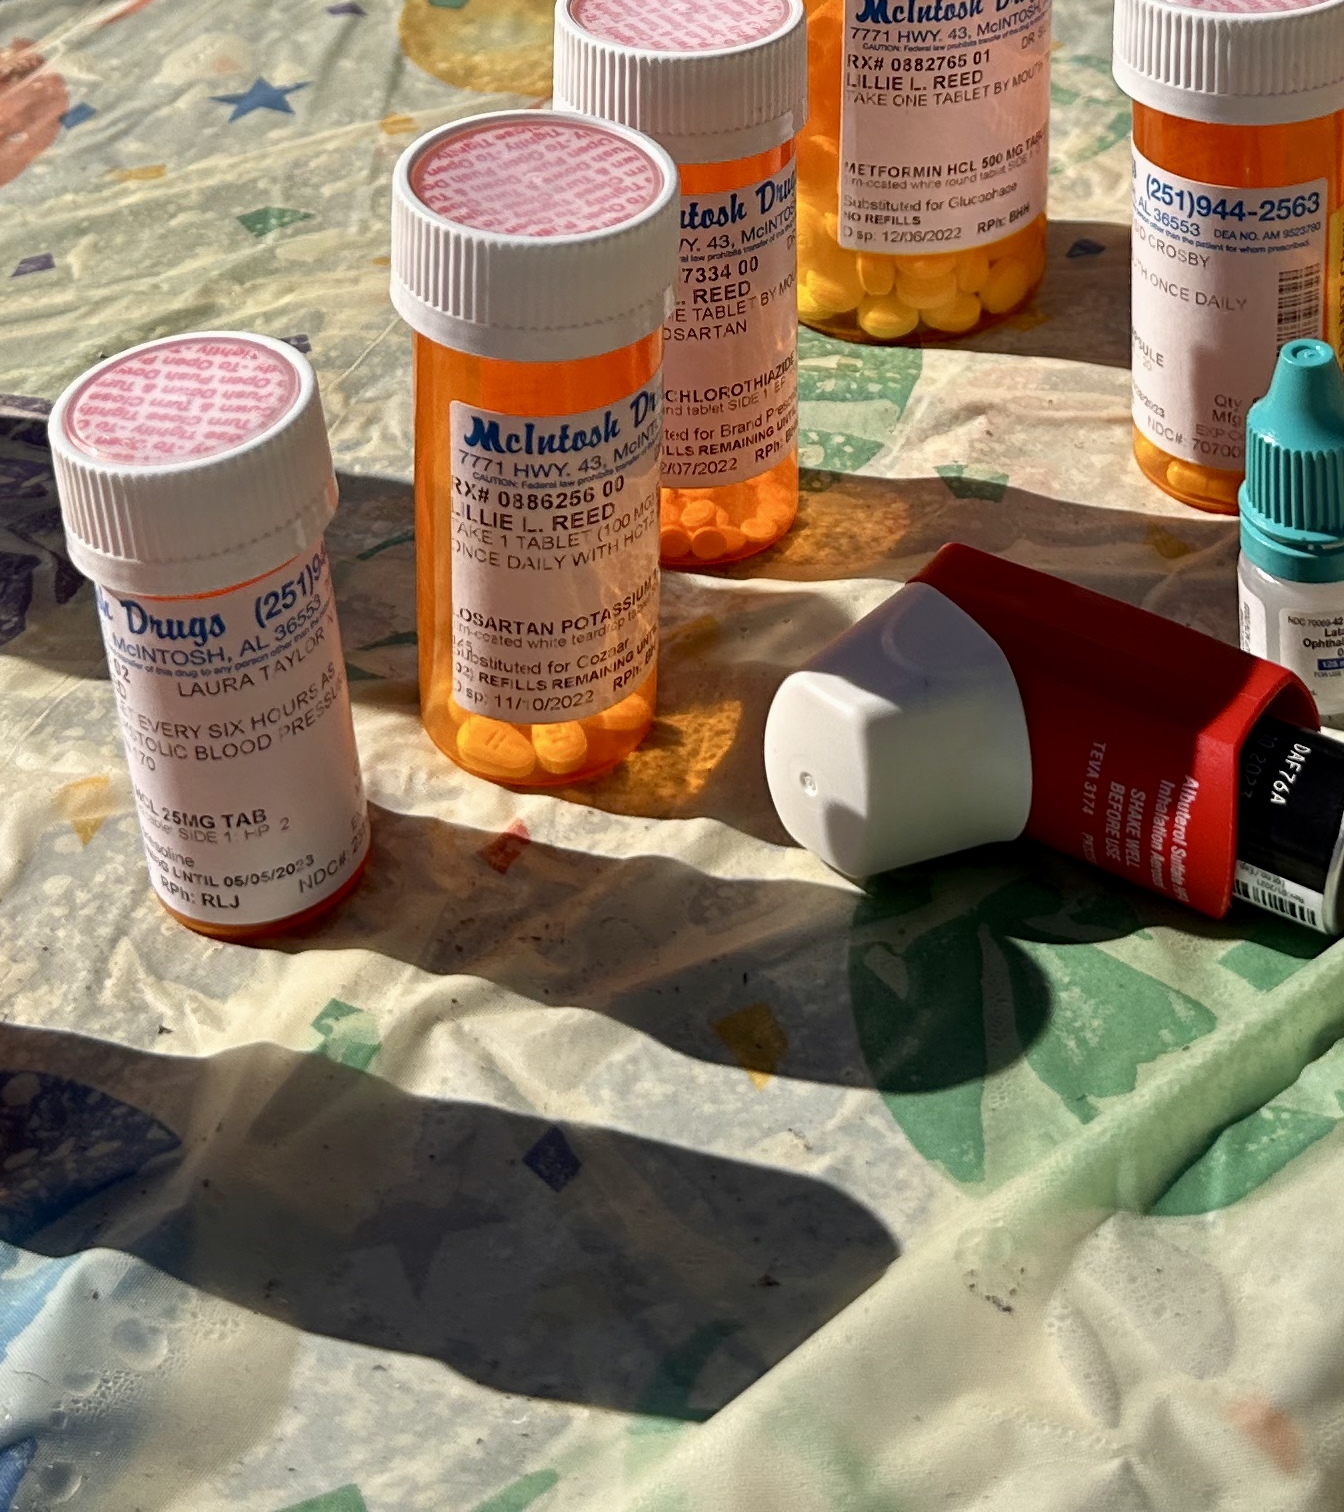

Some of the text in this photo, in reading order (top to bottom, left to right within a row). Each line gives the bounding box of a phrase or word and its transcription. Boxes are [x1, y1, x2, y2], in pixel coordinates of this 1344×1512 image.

[850, 27, 972, 43] 7771 HWY. 43,
[847, 49, 991, 72] RX# 0882765 01
[845, 79, 1010, 108] TAKE ONE TABLET BY
[846, 70, 984, 90] LILLIE L. REED
[845, 143, 1024, 178] METFORMIN HCL 500 MG
[843, 194, 922, 212] Substituted
[926, 199, 945, 211] for
[1146, 173, 1321, 222] (251)944-2563
[865, 213, 922, 225] REFILLS
[1153, 207, 1280, 240] 36553 DEA AM
[707, 234, 735, 250] 43,
[1148, 233, 1211, 271] CROSBY
[738, 256, 760, 276] 00
[693, 280, 751, 305] REED
[693, 285, 777, 322] TABLET BY
[1150, 271, 1248, 312] ONCE DAILY
[728, 395, 759, 411] SIDE
[464, 411, 621, 456] McIntosh
[694, 417, 763, 441] for Brand
[698, 425, 774, 456] REMAINING
[458, 449, 606, 479] 7771 HWY. 43,
[473, 472, 575, 489] CAUTION: Federal law
[452, 474, 625, 511] RX# 0886256 00
[452, 496, 616, 533] LILLIE L. REED
[452, 518, 592, 551] TAKE TABLET
[452, 536, 619, 570] ONCE DAILY WITH
[112, 594, 322, 667] McINTOSH, AL 36553
[121, 599, 227, 647] Drugs
[176, 630, 326, 698] LAURA TAYLOR
[478, 650, 634, 691] REFILLS REMAINING
[547, 661, 570, 674] for
[576, 637, 630, 670] Cozaar
[137, 682, 319, 741] EVERY SIX HOURS
[195, 732, 273, 762] BLOOD
[1086, 741, 1106, 779] TEVA
[1082, 781, 1097, 815] 3174
[1150, 779, 1176, 851] Inhalation
[1172, 774, 1200, 846] Albuterol
[162, 806, 268, 830] 25MG TAB
[1105, 780, 1126, 861] BEFORE USE
[1125, 788, 1146, 868] SHAKE WELL
[178, 828, 219, 845] SIDE
[172, 852, 316, 889] UNTIL 05/05/2023
[160, 874, 241, 910] RPh: RLJ
